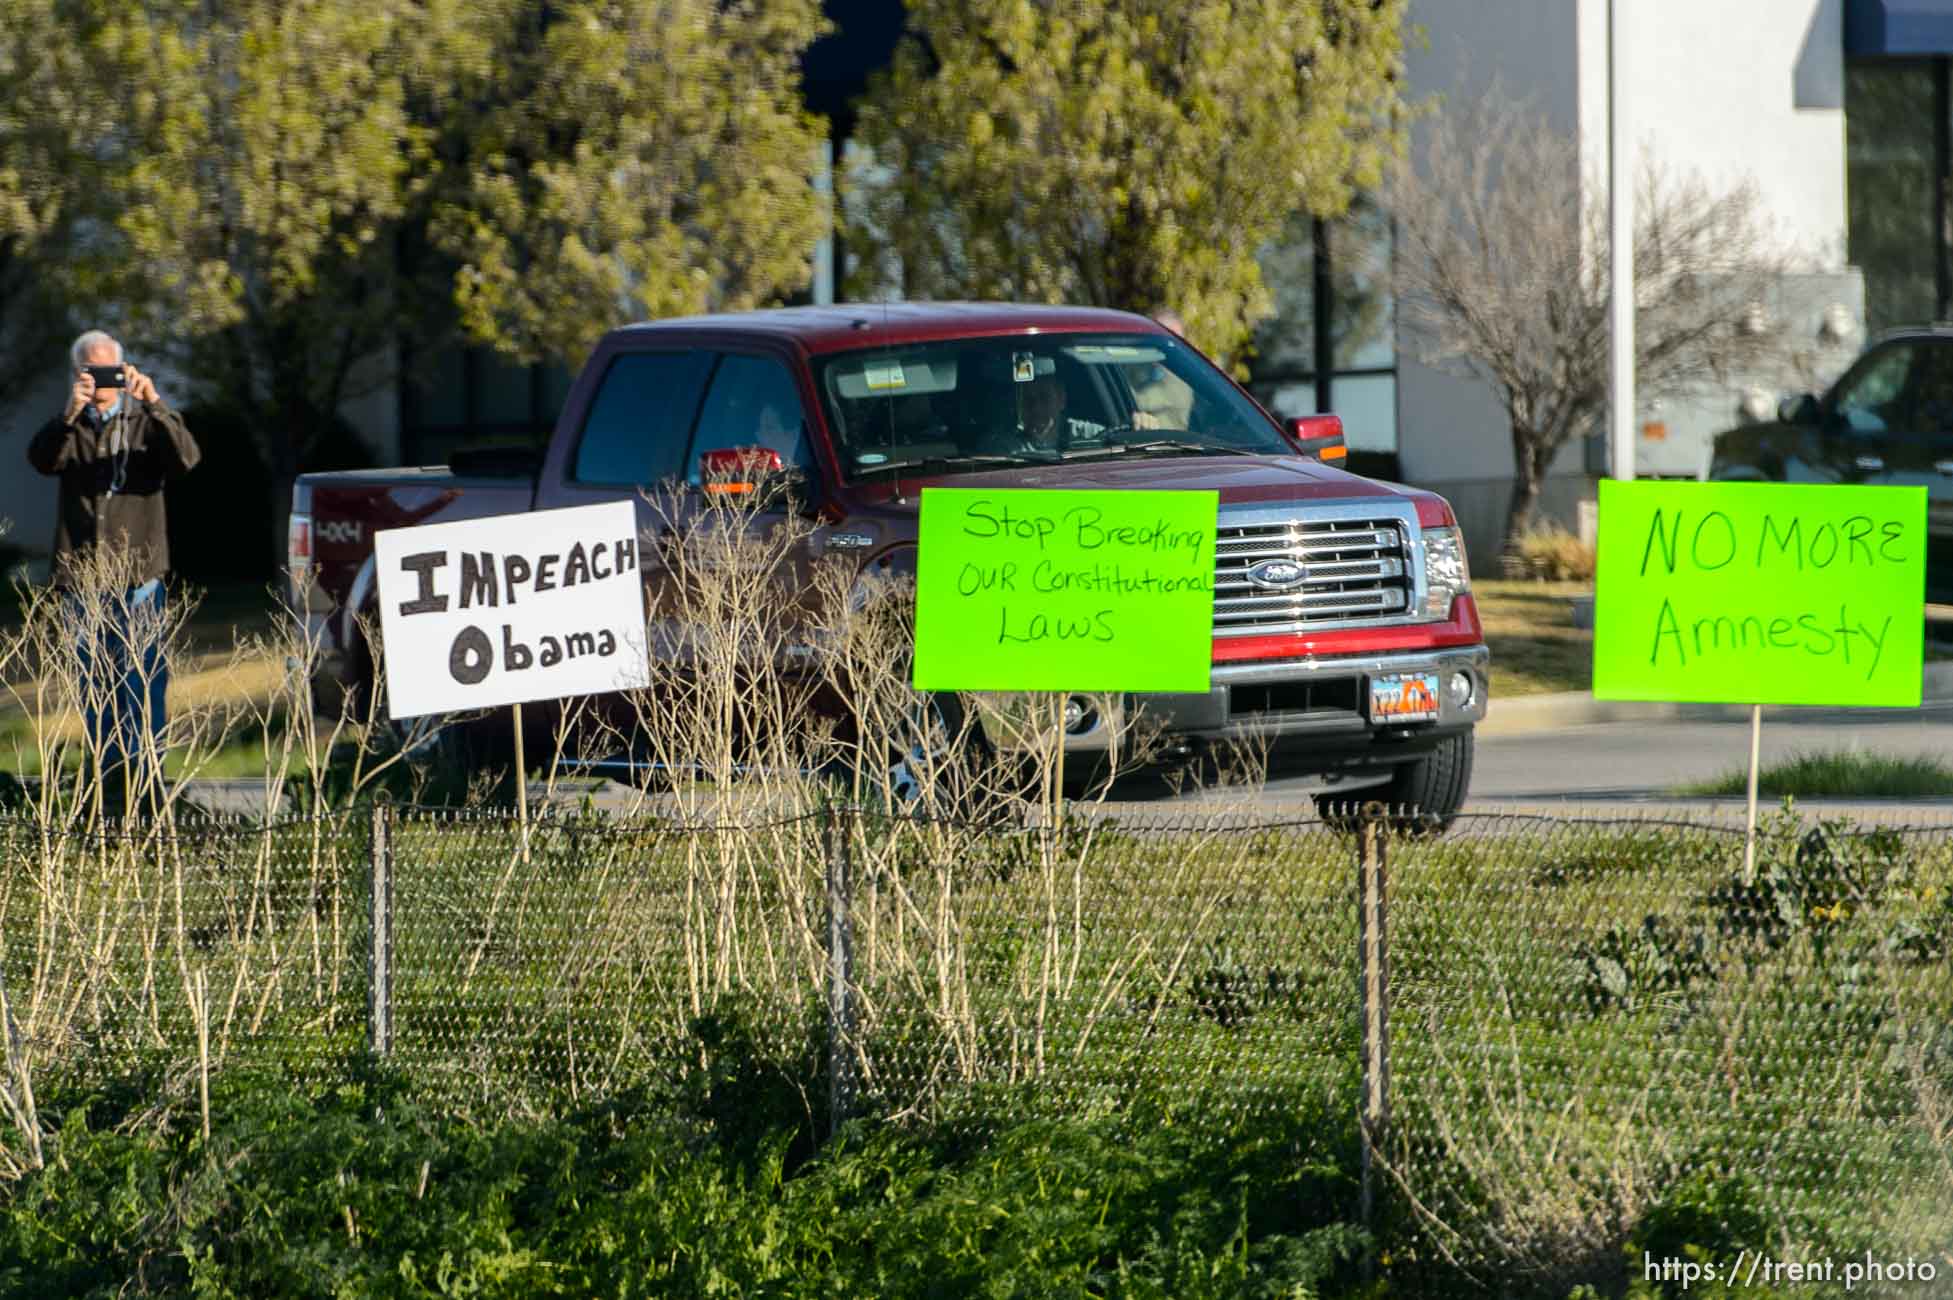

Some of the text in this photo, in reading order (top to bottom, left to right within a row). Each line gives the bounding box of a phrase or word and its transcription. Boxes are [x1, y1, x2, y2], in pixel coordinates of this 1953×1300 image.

[963, 500, 1204, 565] Stop Breaking
[1641, 507, 1907, 577] NO MORE
[400, 538, 635, 617] IMPEACH
[1033, 559, 1216, 596] Constitutional
[449, 624, 617, 685] Obama
[1650, 597, 1893, 681] Amnesty
